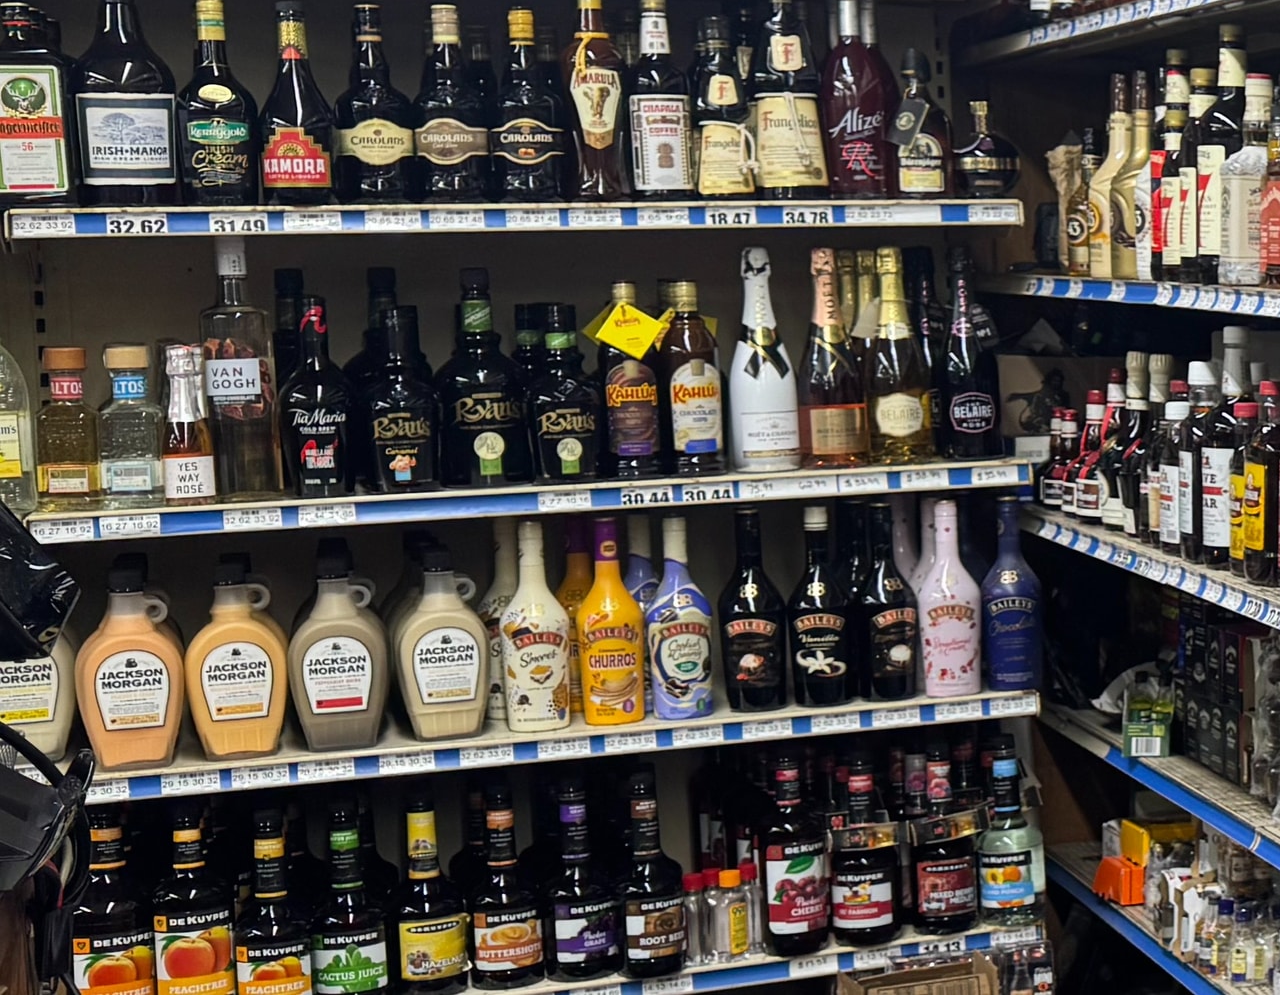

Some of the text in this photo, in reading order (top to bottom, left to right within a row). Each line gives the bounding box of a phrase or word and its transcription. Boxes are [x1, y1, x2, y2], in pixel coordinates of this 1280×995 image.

[829, 108, 883, 138] Alizé
[351, 135, 405, 146] CAROLANS
[421, 133, 473, 144] CAROLANS
[192, 151, 248, 168] Cream
[264, 159, 325, 174] KAMORA
[786, 211, 828, 224] 34.78
[109, 219, 165, 233] 32.62
[211, 367, 243, 377] VAN
[212, 377, 256, 390] GOGH
[606, 383, 658, 407] KAHLÚA
[290, 408, 346, 426] Tia Maria
[455, 397, 522, 429] Ryan's
[953, 405, 993, 419] BELAIRE
[373, 417, 431, 440] Ryan's
[177, 461, 198, 472] YES
[177, 473, 200, 483] WAY
[176, 481, 204, 494] ROSÉ
[205, 660, 267, 673] JACKSON
[588, 653, 636, 669] CHURROS
[99, 669, 163, 681] JACKSON
[207, 670, 266, 682] MORGAN
[101, 677, 162, 689] MORGAN
[639, 935, 666, 946] ROOT
[318, 966, 384, 982] CACTUS JUICE
